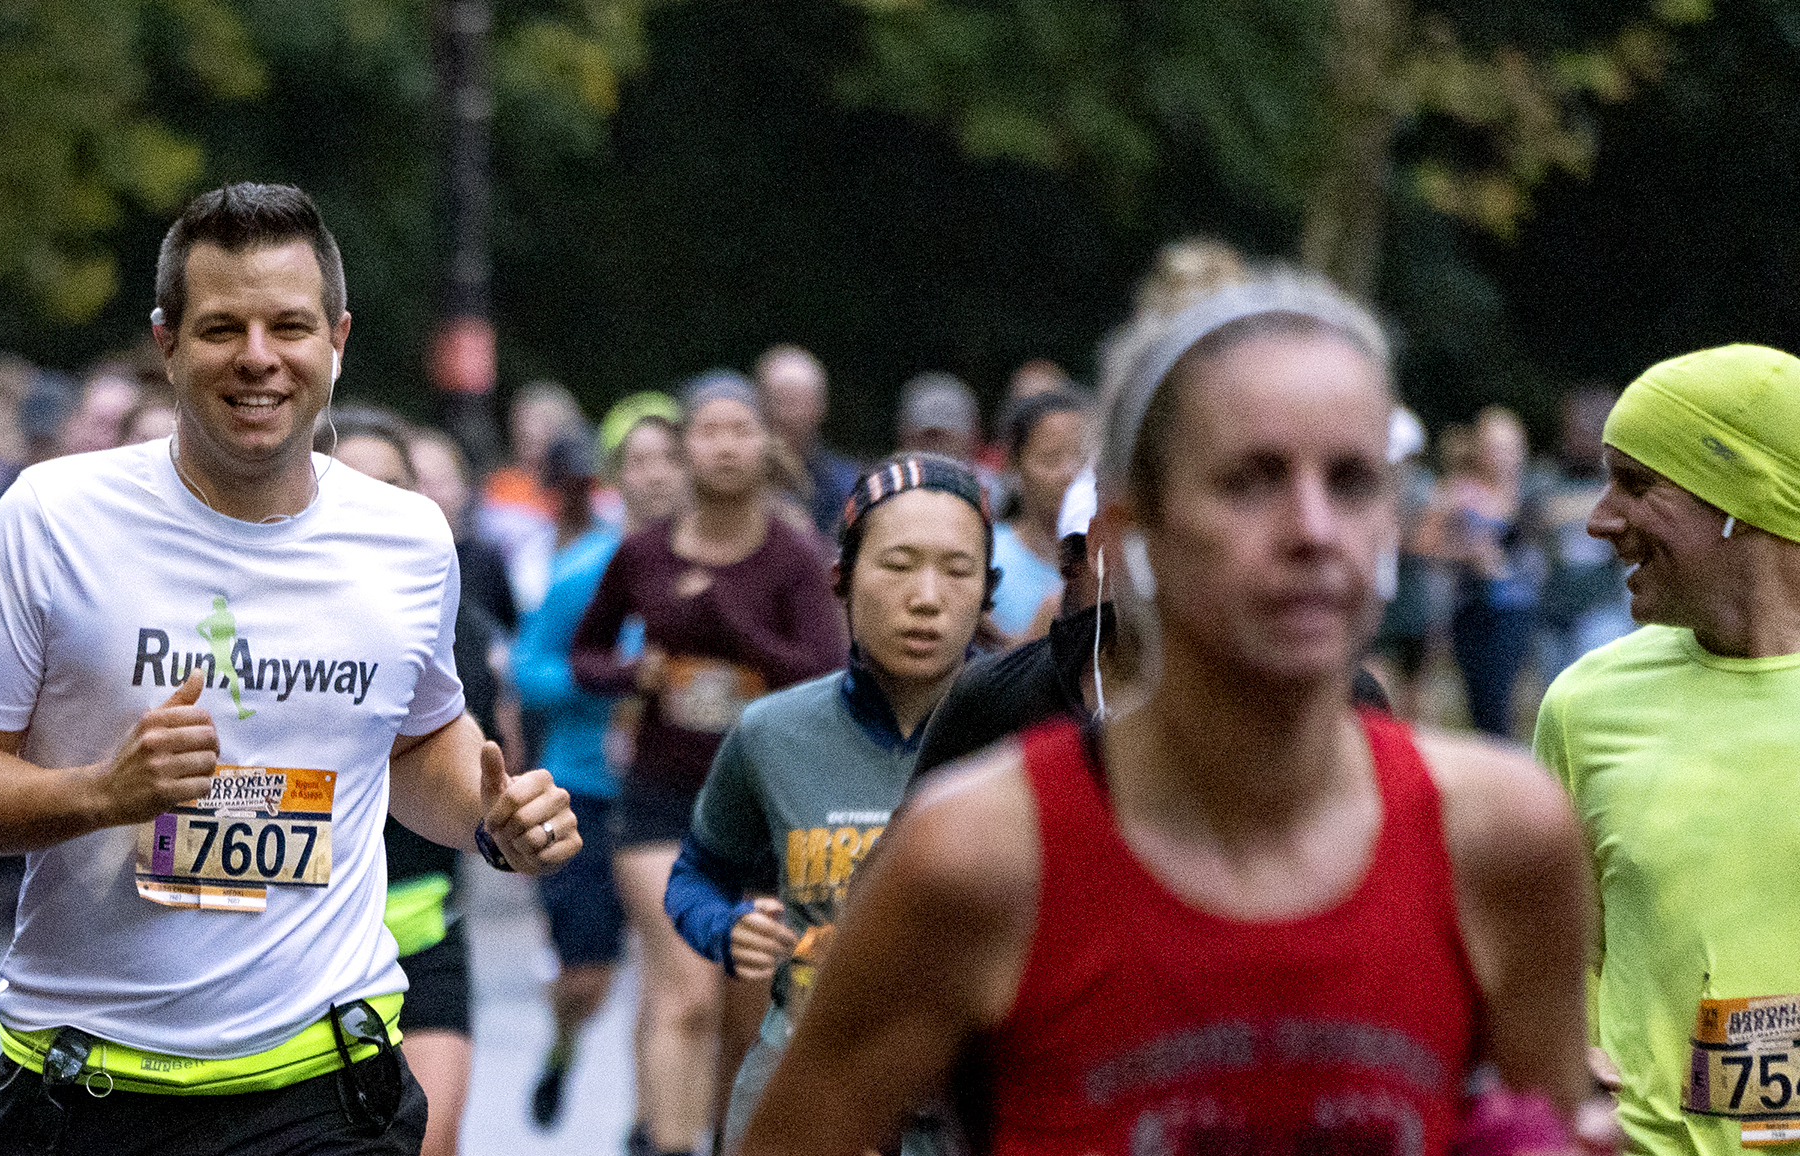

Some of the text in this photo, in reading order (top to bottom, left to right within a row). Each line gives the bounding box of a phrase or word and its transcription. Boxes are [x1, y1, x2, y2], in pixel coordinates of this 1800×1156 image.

[158, 835, 171, 850] E
[188, 819, 318, 879] 7607
[1721, 1053, 1800, 1110] 75
